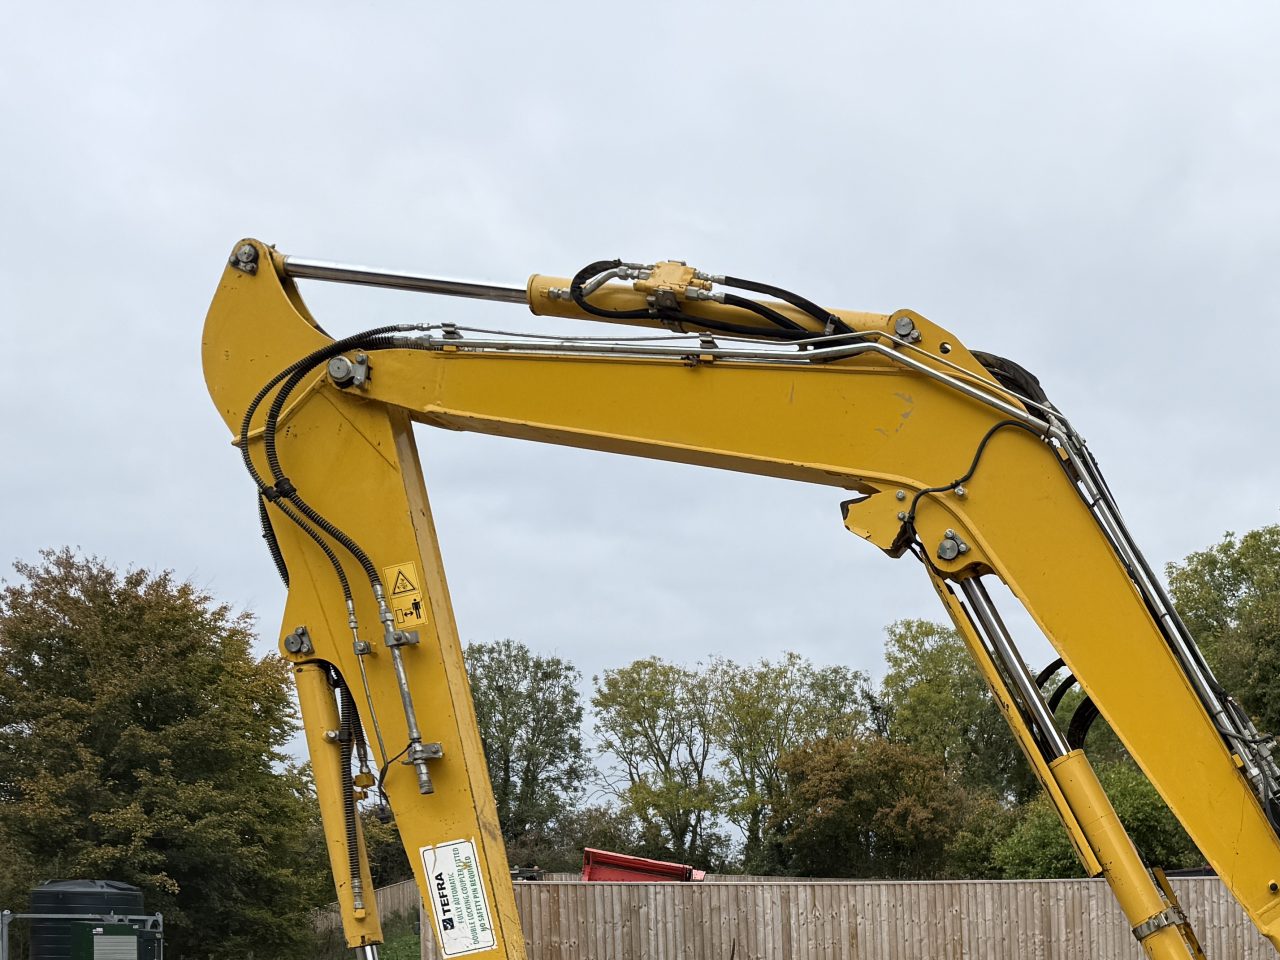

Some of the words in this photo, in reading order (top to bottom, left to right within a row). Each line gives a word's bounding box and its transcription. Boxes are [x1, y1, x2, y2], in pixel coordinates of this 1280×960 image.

[447, 872, 460, 906] AUTOMATIC
[457, 867, 468, 895] COUPLER
[434, 872, 451, 916] TEFRA
[455, 906, 465, 924] FULLY
[463, 895, 474, 921] LOCKING
[474, 900, 484, 922] SAFETY
[469, 921, 480, 945] DOUBLE
[478, 922, 487, 932] NO
